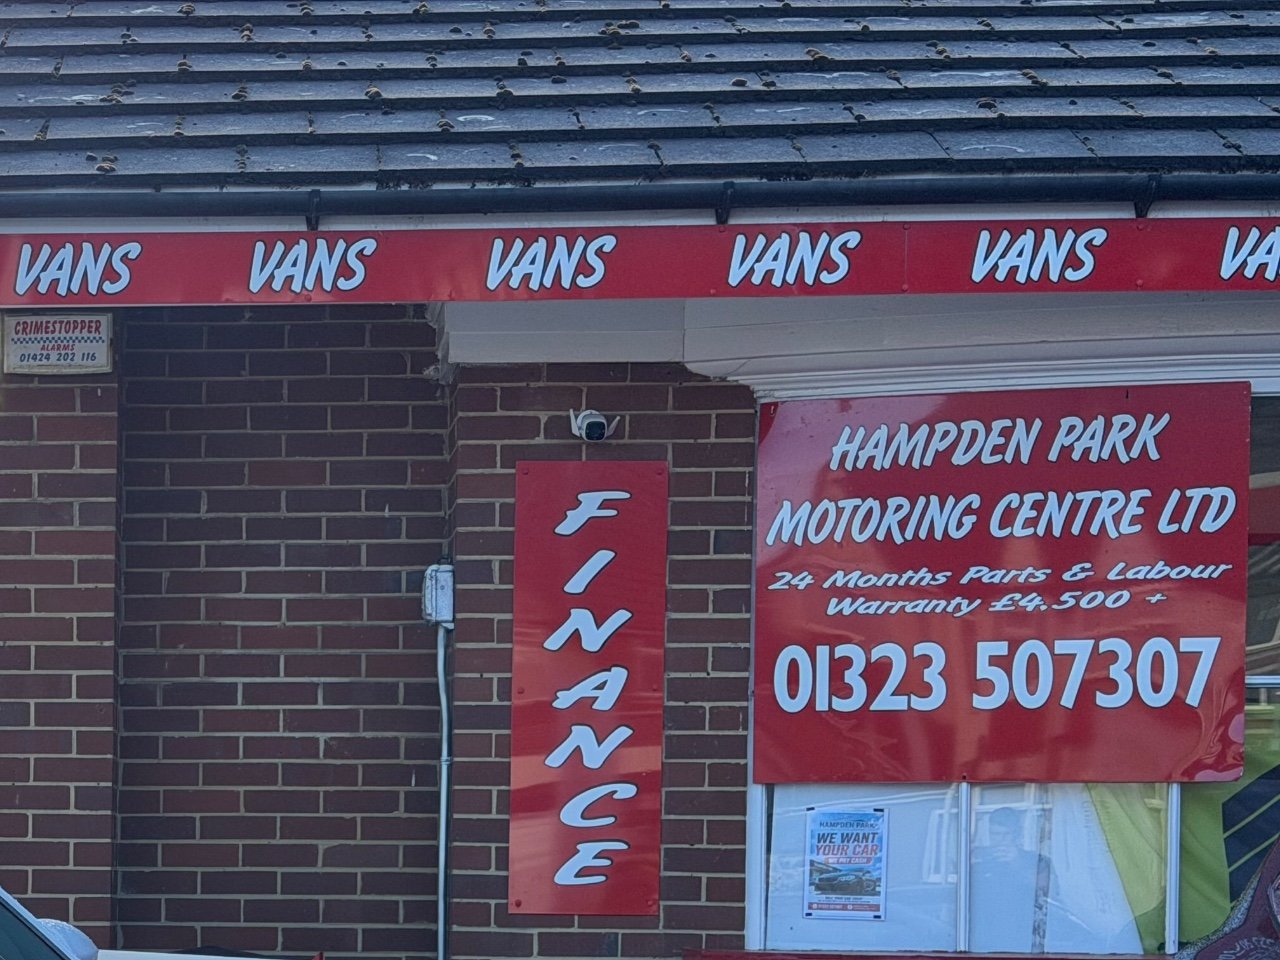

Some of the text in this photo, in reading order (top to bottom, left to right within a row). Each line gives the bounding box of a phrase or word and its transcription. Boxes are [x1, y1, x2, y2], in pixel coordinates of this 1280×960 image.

[15, 242, 142, 297] VANS
[249, 238, 377, 293] VANS
[486, 235, 617, 291] VANS
[728, 231, 861, 288] VANS
[971, 228, 1107, 284] VANS
[1220, 226, 1280, 281] VA
[14, 320, 102, 336] CRIMESTOPPER
[40, 344, 76, 352] ALARMS
[20, 352, 97, 362] 01424 202 116
[829, 413, 1170, 472] HAMPDEN PARK
[765, 486, 1237, 546] MOTORING CENTRE LTD
[767, 560, 1233, 590] 24 Months Parts & Labour
[826, 596, 983, 618] Warranty
[543, 490, 638, 886] FINANCE
[773, 637, 1223, 713] 01323 507307
[816, 844, 879, 856] YOUR CAR
[817, 832, 878, 844] WE WANT
